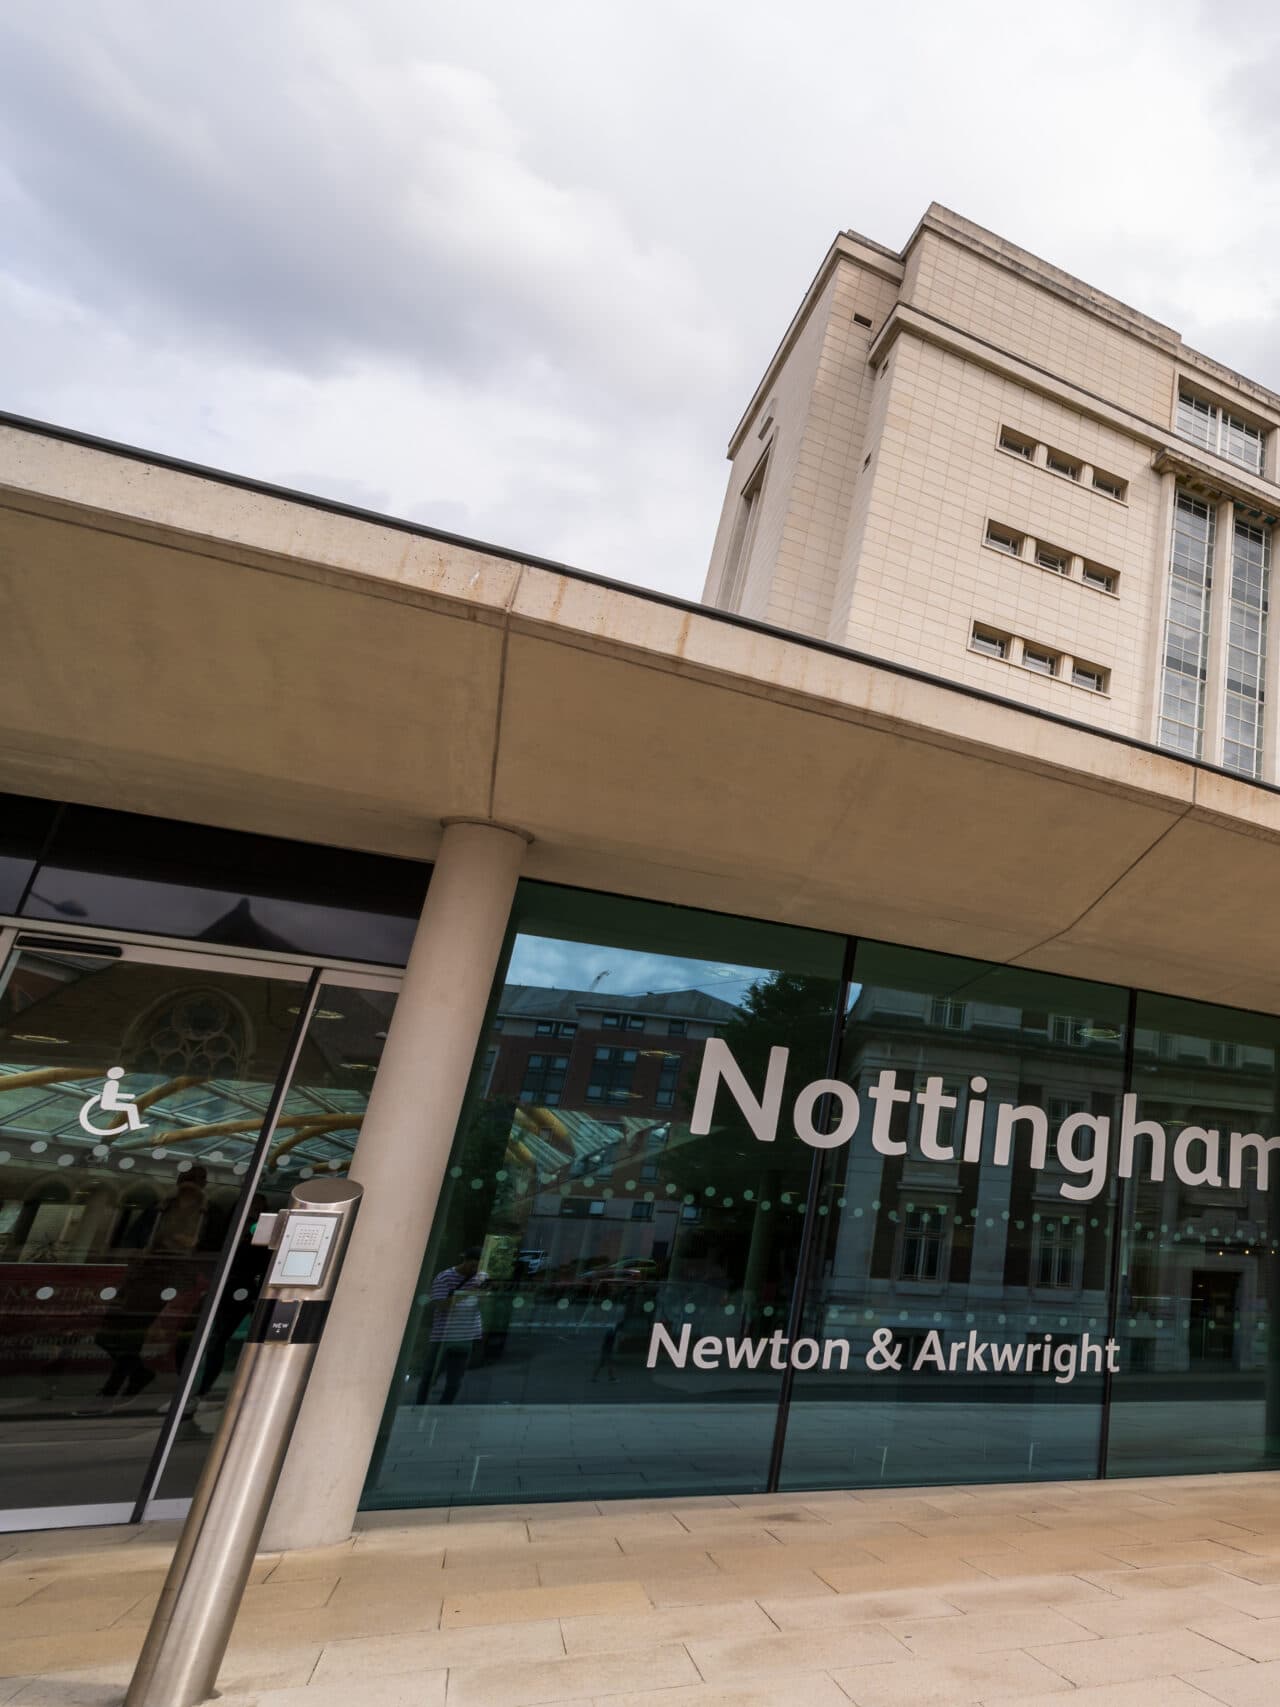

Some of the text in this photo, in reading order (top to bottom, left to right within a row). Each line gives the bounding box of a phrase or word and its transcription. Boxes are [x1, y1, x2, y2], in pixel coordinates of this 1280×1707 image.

[646, 1322, 1121, 1384] Newton & Arkwright
